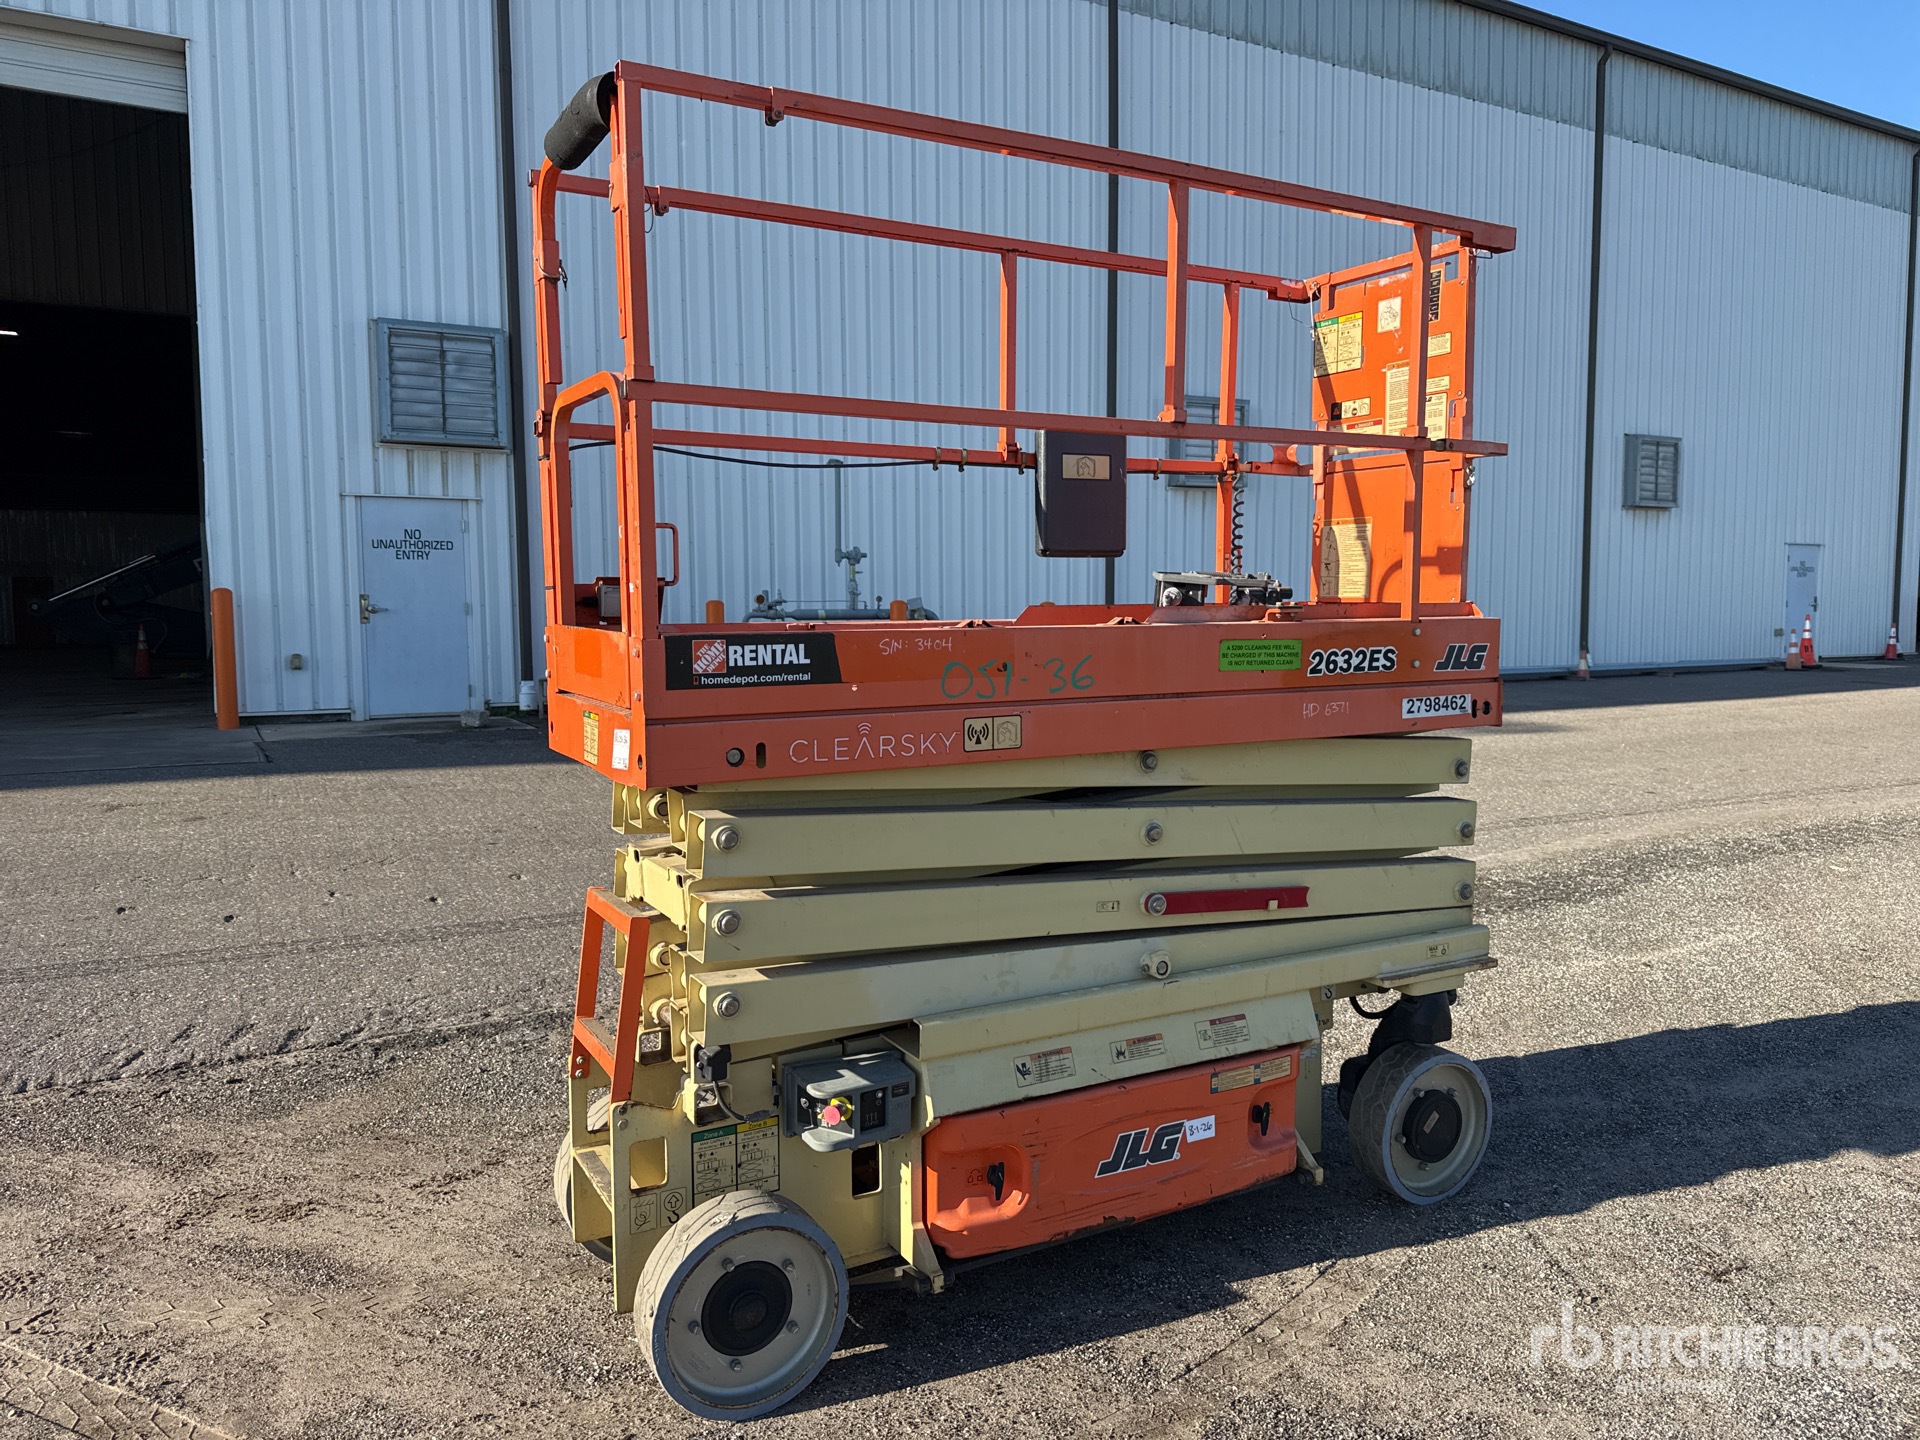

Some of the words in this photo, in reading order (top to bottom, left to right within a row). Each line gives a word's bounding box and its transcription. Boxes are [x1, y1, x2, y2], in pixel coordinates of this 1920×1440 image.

[404, 529, 421, 540] NO
[372, 539, 454, 550] UNAUTHORIZED
[396, 550, 430, 560] ENTRY
[696, 643, 710, 657] THE
[879, 638, 908, 655] S/N:
[915, 637, 952, 651] 3404
[694, 640, 726, 673] HOME
[706, 652, 726, 673] DEPOT
[729, 644, 810, 667] RENTAL
[1308, 647, 1397, 676] 2632ES
[1434, 644, 1490, 672] JLG
[701, 672, 810, 685] homedepot.com/rental
[1303, 703, 1319, 719] HD
[1325, 702, 1349, 716] 6371
[1406, 695, 1466, 714] 2798462
[789, 732, 956, 763] CLEARSKY
[1188, 1121, 1213, 1136] 8-1-26
[1096, 1120, 1186, 1177] JLG
